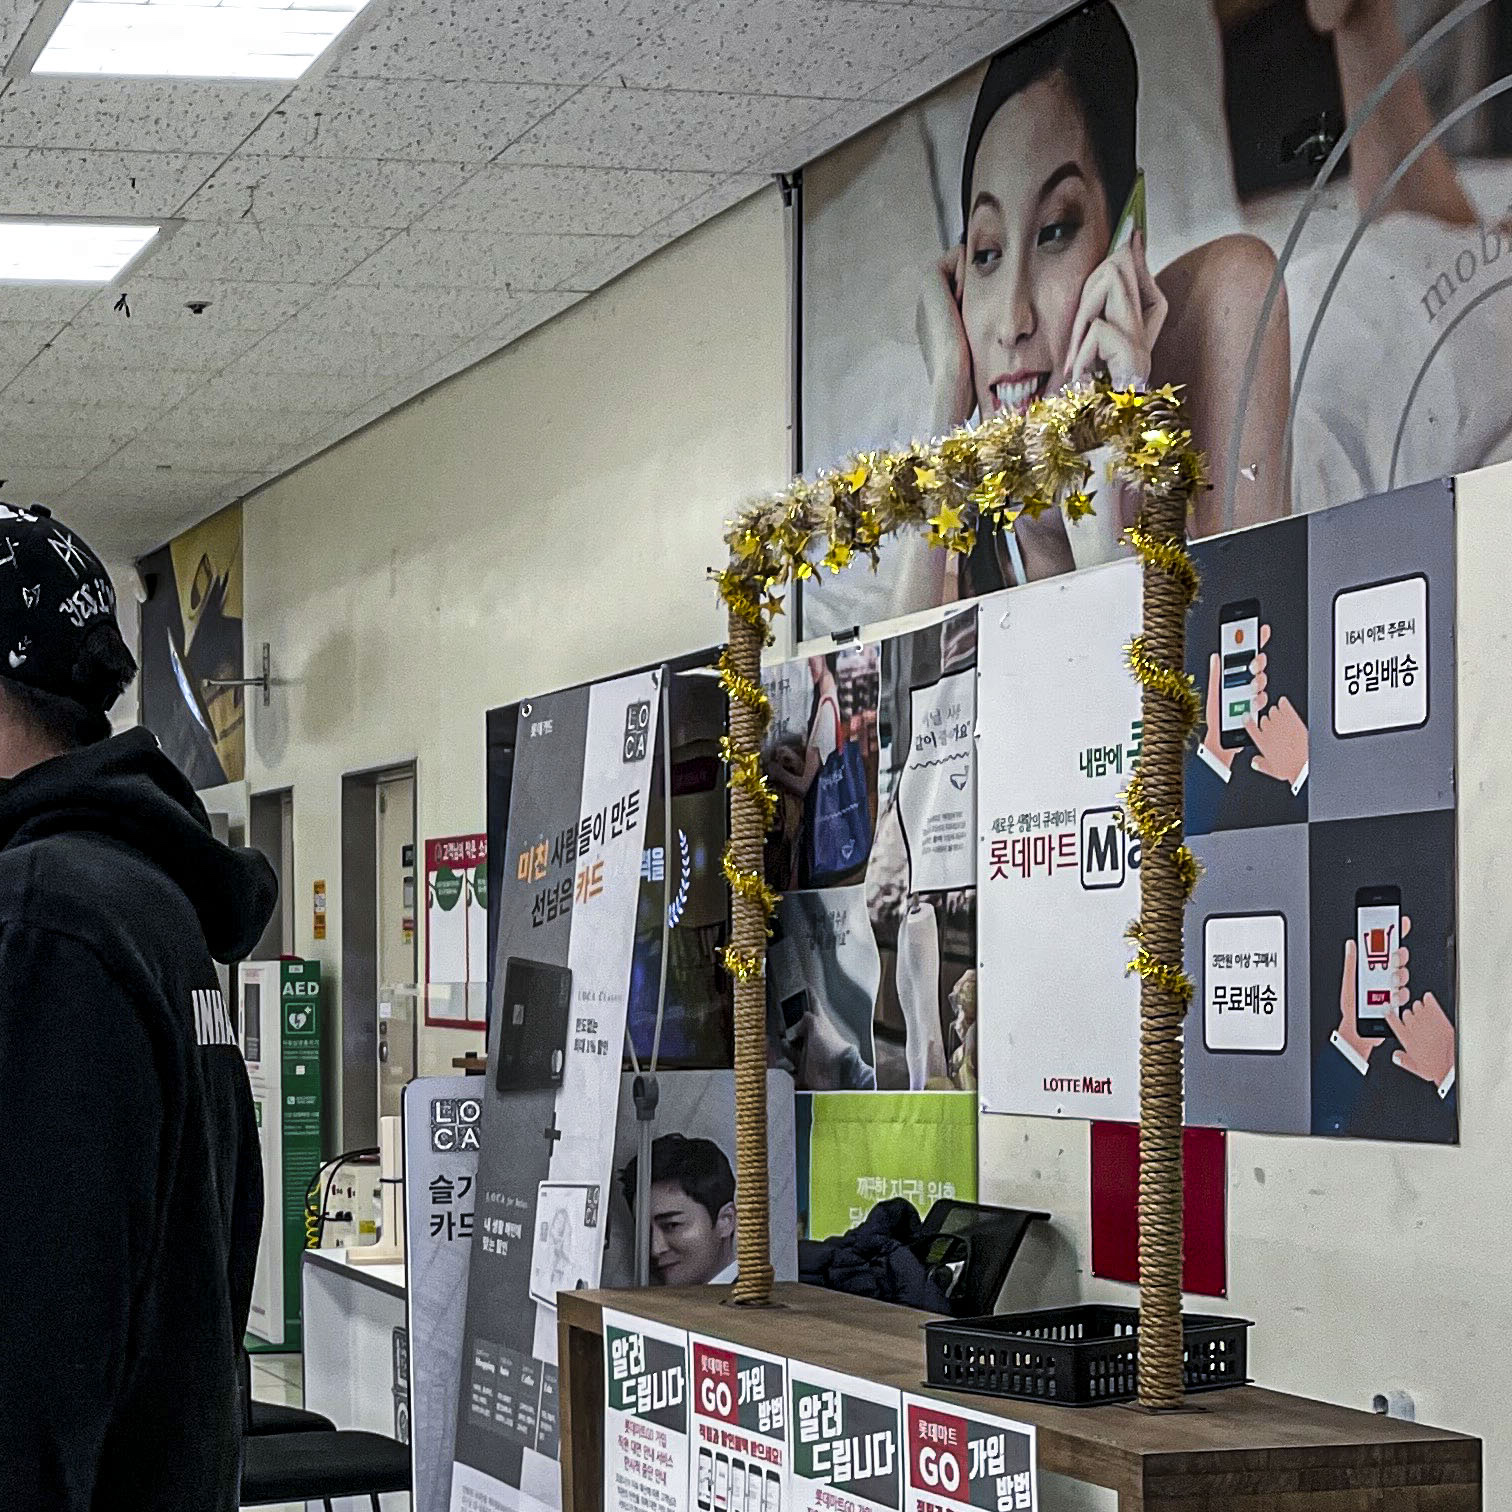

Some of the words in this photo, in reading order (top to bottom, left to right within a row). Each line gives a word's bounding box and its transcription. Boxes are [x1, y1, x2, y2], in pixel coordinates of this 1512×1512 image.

[1345, 628, 1365, 645] 16시
[1367, 624, 1386, 643] 이전
[1387, 618, 1416, 639] 주문시
[1344, 653, 1419, 695] 당일배송
[1079, 743, 1123, 778] 내맘에
[517, 838, 549, 884] 미친
[550, 806, 608, 868] 사람들이
[611, 789, 640, 839] 만든
[989, 832, 1079, 881] 롯데마트
[531, 877, 573, 928] 선넘은
[575, 858, 605, 904] 카드
[1212, 953, 1233, 968] 3만원
[1234, 953, 1251, 969] 이상
[1252, 952, 1278, 968] 구매시
[283, 981, 320, 996] AED
[1212, 984, 1278, 1015] 무료배송
[1043, 1078, 1080, 1093] LOTTE
[1082, 1076, 1112, 1095] Mart
[436, 1100, 481, 1122] LO
[434, 1127, 480, 1150] CA
[611, 1334, 646, 1380] 알려
[701, 1354, 730, 1377] 롯데마트
[622, 1366, 685, 1415] 드립니다
[701, 1377, 733, 1417] GO
[737, 1364, 766, 1406] 가입
[757, 1396, 784, 1433] 방법
[798, 1390, 843, 1443] 알려
[918, 1419, 958, 1446] 롯데마트
[812, 1430, 896, 1484] 드립니다
[919, 1446, 961, 1493] GO
[967, 1433, 1006, 1481] 가입
[995, 1471, 1032, 1512] 방법
